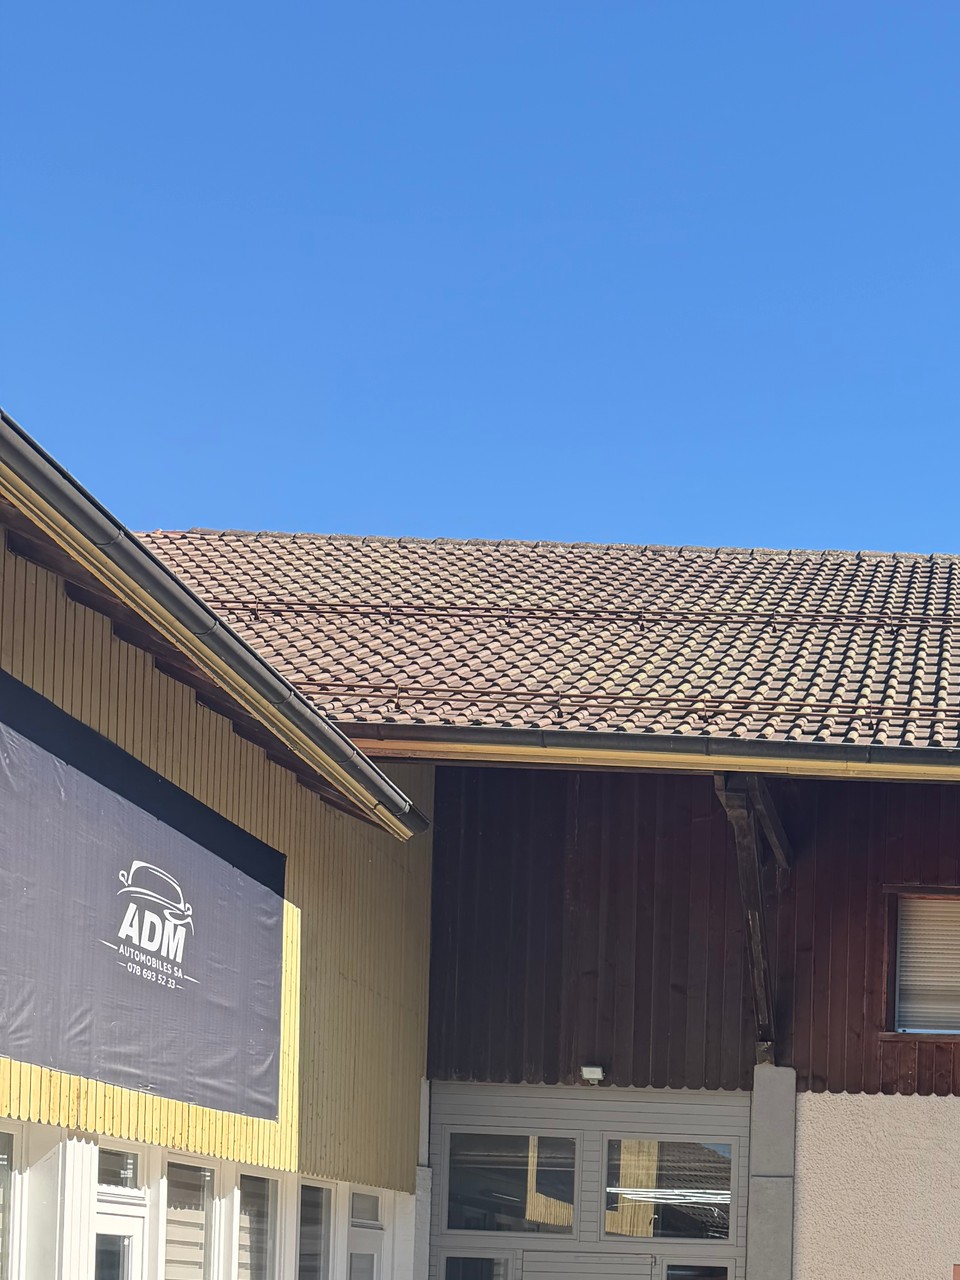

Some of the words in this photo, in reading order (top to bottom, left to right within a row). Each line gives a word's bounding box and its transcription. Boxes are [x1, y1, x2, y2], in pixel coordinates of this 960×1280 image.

[118, 902, 186, 963] ADM
[118, 944, 172, 974] AUTOMOBILES
[173, 966, 183, 979] SA
[127, 962, 141, 976] 078
[142, 968, 156, 982] 693
[157, 974, 166, 986] 52
[167, 977, 176, 989] 33
